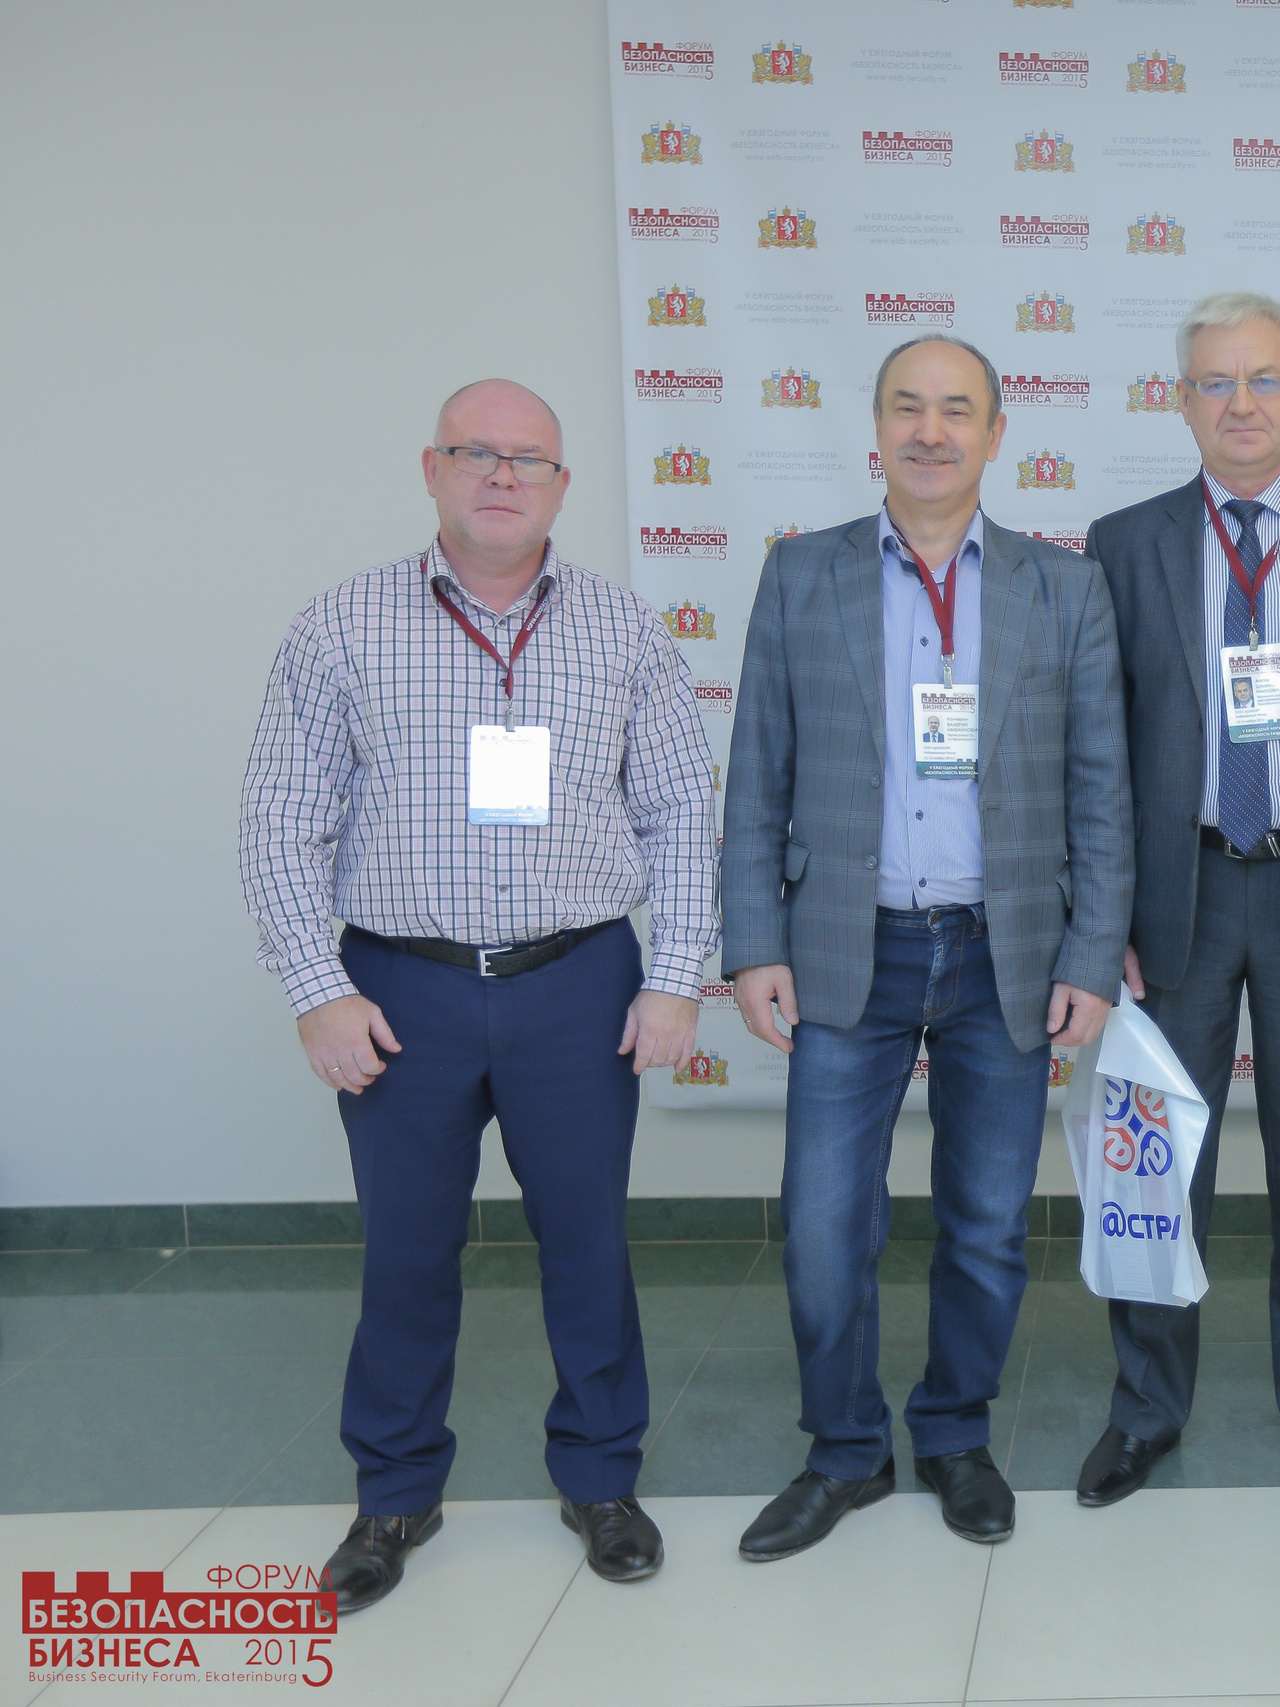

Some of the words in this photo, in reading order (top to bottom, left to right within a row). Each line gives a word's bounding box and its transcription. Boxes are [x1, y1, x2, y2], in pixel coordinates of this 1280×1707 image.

[675, 42, 712, 51] ФОРУМ
[624, 50, 713, 62] БЕЗОПАСНОСТЬ
[1052, 52, 1088, 60] ФОРУМ
[625, 62, 675, 73] БИЗНЕСА
[688, 64, 714, 80] 2015
[1002, 60, 1088, 71] БЕЗОПАСНОСТЬ
[1002, 72, 1050, 82] БИЗНЕСА
[1063, 73, 1088, 88] 2015
[915, 130, 951, 138] ФОРУМ
[865, 139, 952, 150] БЕЗОПАСНОСТЬ
[865, 151, 914, 161] БИЗНЕСА
[926, 152, 952, 167] 2015
[681, 207, 717, 215] ФОРУМ
[631, 216, 718, 226] БЕЗОПАСНОСТЬ
[1052, 214, 1088, 222] ФОРУМ
[1003, 224, 1088, 234] БЕЗОПАСНОСТЬ
[632, 228, 681, 237] БИЗНЕСА
[692, 228, 718, 244] 2015
[1003, 235, 1051, 244] БИЗНЕСА
[1063, 236, 1088, 251] 2015
[868, 302, 954, 312] БЕЗОПАСНОСТЬ
[868, 313, 917, 322] БИЗНЕСА
[929, 314, 954, 329] 2015
[638, 378, 722, 387] БЕЗОПАСНОСТЬ
[1004, 383, 1089, 393] БЕЗОПАСНОСТЬ
[638, 389, 686, 398] БИЗНЕСА
[698, 389, 722, 404] 2015
[1005, 394, 1053, 403] БИЗНЕСА
[1064, 395, 1090, 409] 2015
[644, 535, 727, 544] БЕЗОПАСНОСТЬ
[644, 546, 691, 555] БИЗНЕСА
[702, 547, 727, 561] 2015
[708, 700, 732, 714] 2015
